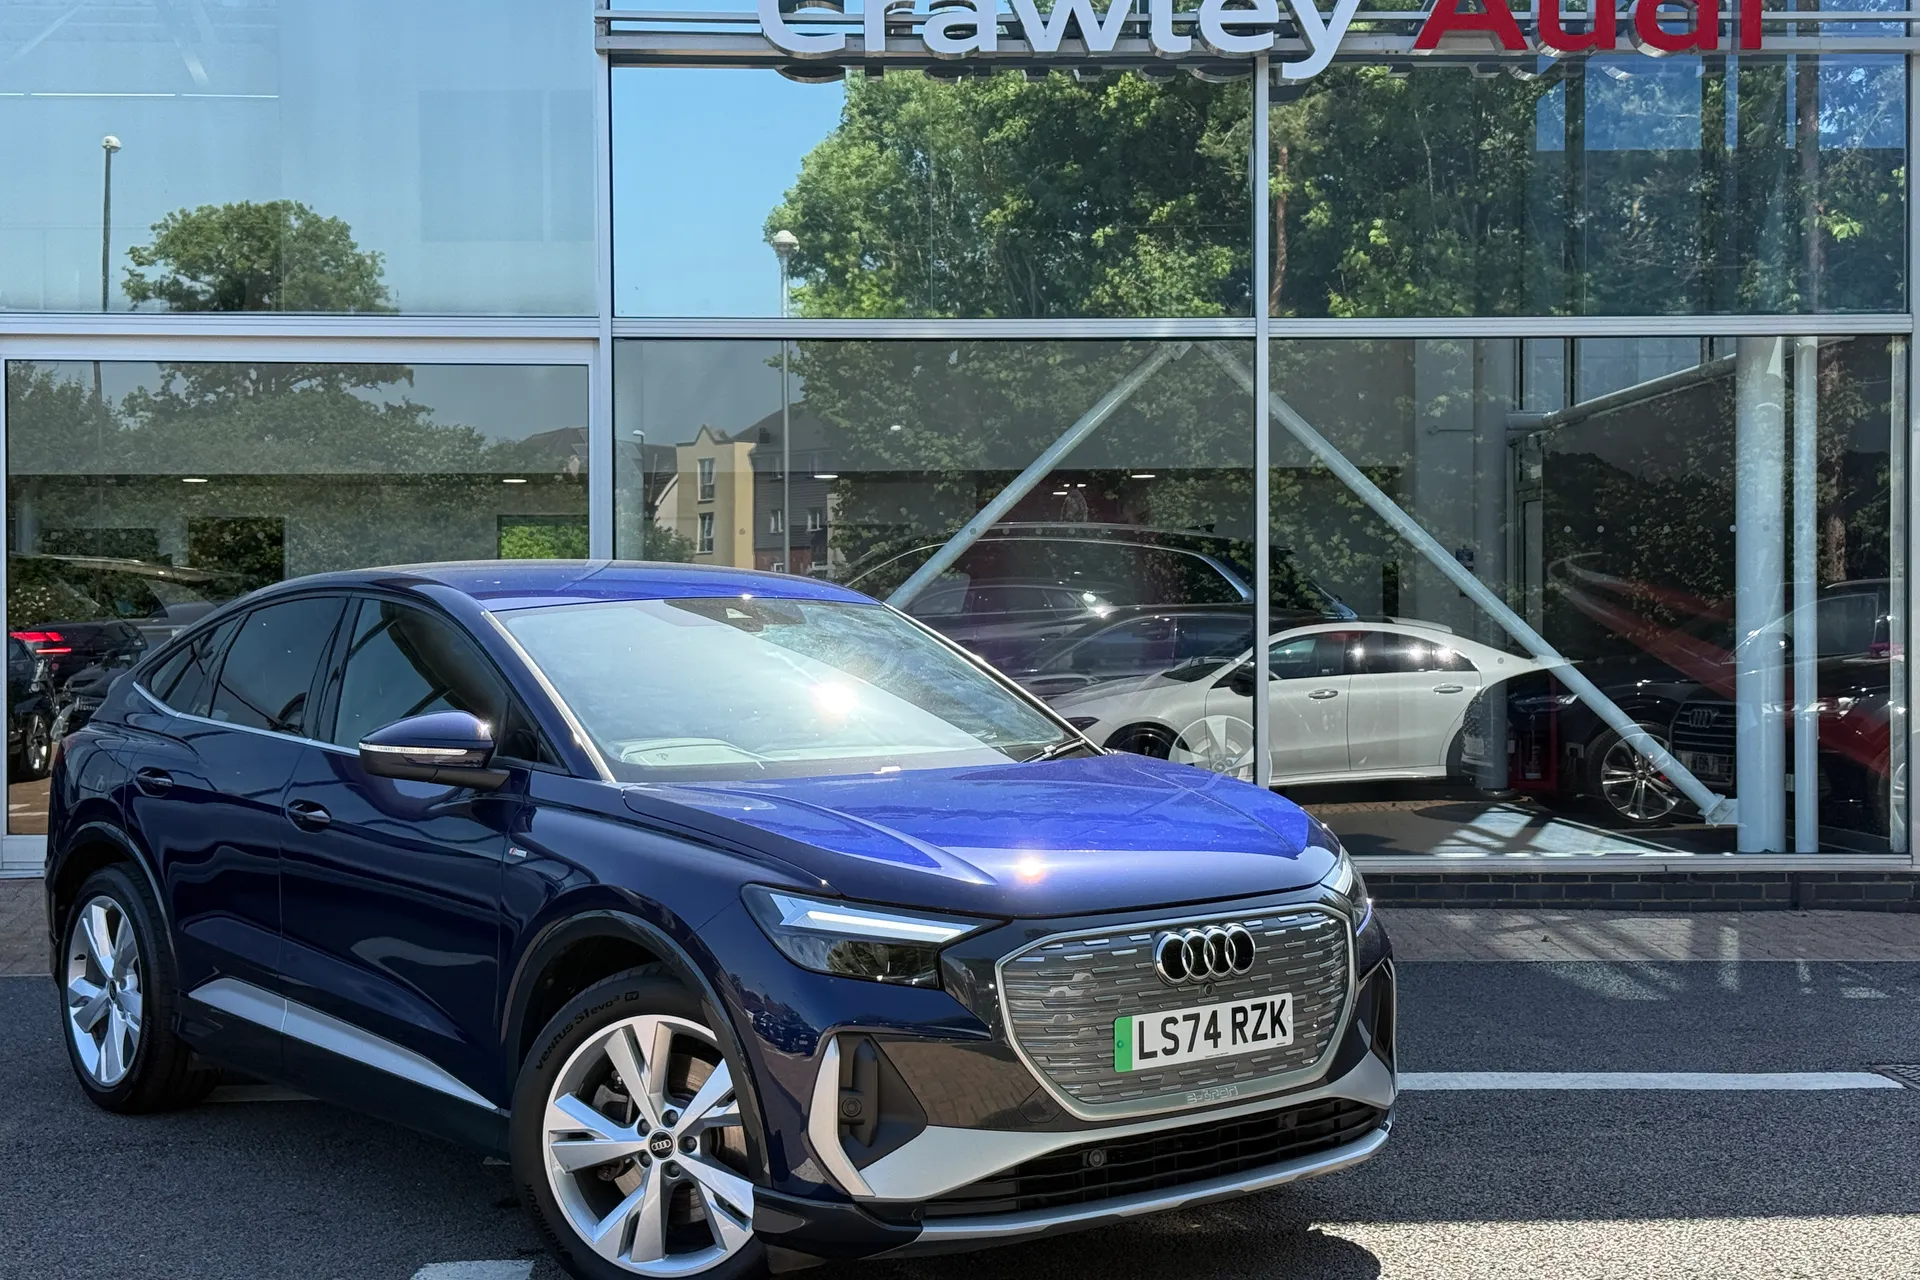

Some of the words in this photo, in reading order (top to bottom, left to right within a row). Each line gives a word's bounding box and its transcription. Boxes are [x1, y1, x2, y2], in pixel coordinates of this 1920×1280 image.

[758, 0, 1360, 80] Crawley
[1413, 0, 1762, 54] Audi
[1138, 1010, 1222, 1060] LS74
[1231, 998, 1288, 1046] RZK
